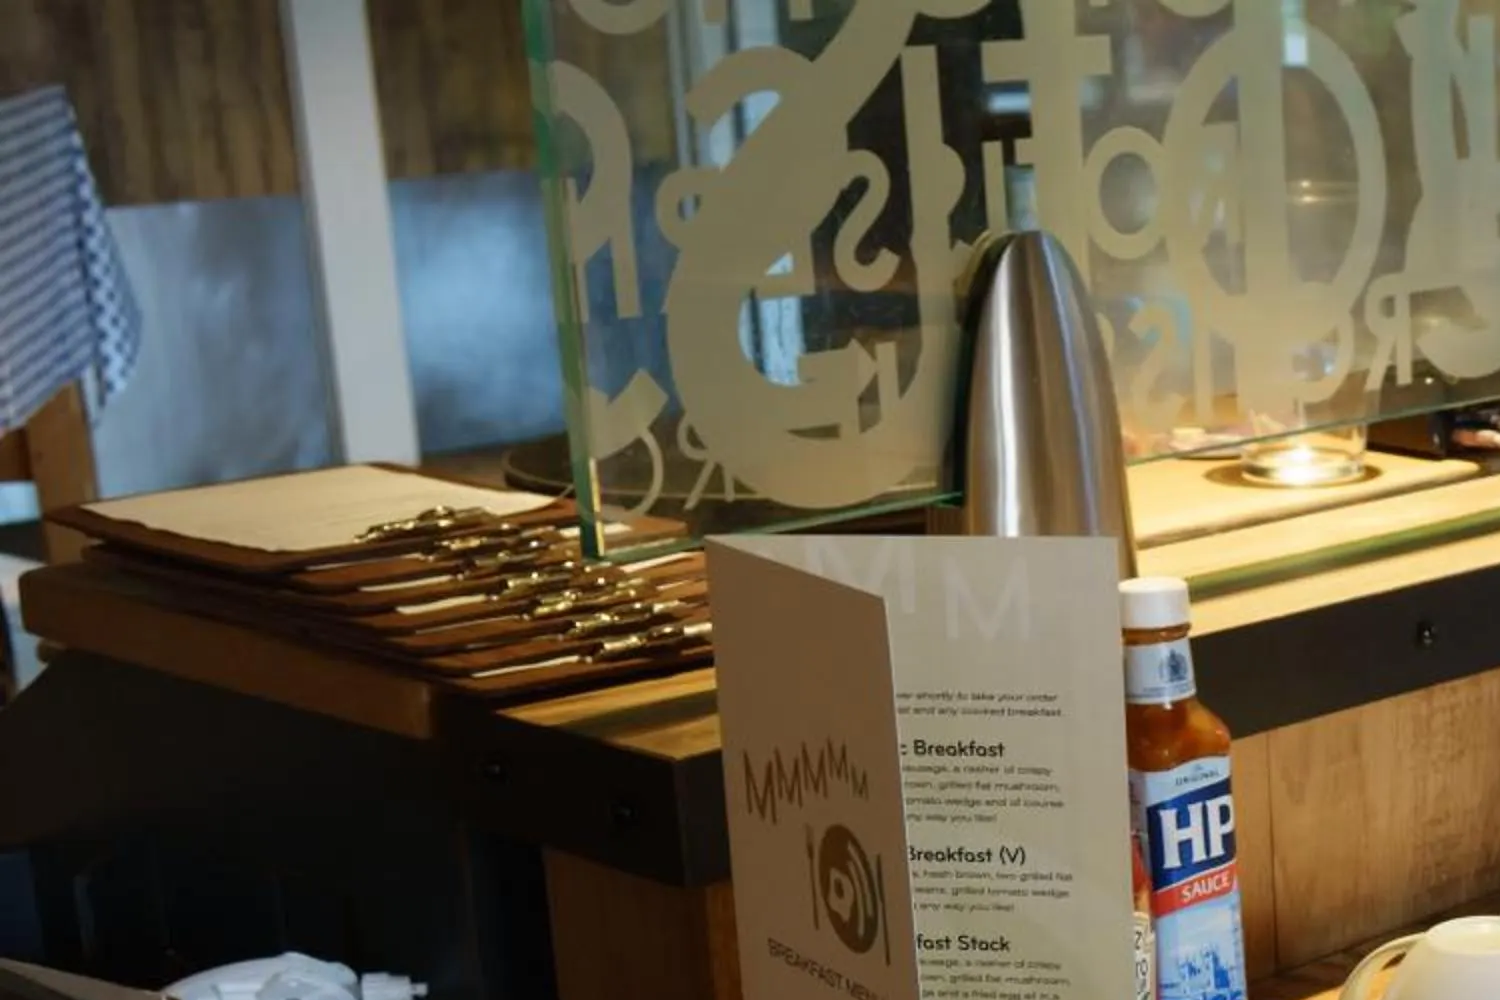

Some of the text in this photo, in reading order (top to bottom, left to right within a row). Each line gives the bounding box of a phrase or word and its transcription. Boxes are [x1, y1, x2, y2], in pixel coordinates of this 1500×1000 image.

[913, 739, 1005, 758] Breakfast
[1158, 794, 1236, 869] HP
[999, 846, 1026, 865] (V)
[1181, 870, 1231, 903] SAUCE
[957, 935, 1012, 952] Stack
